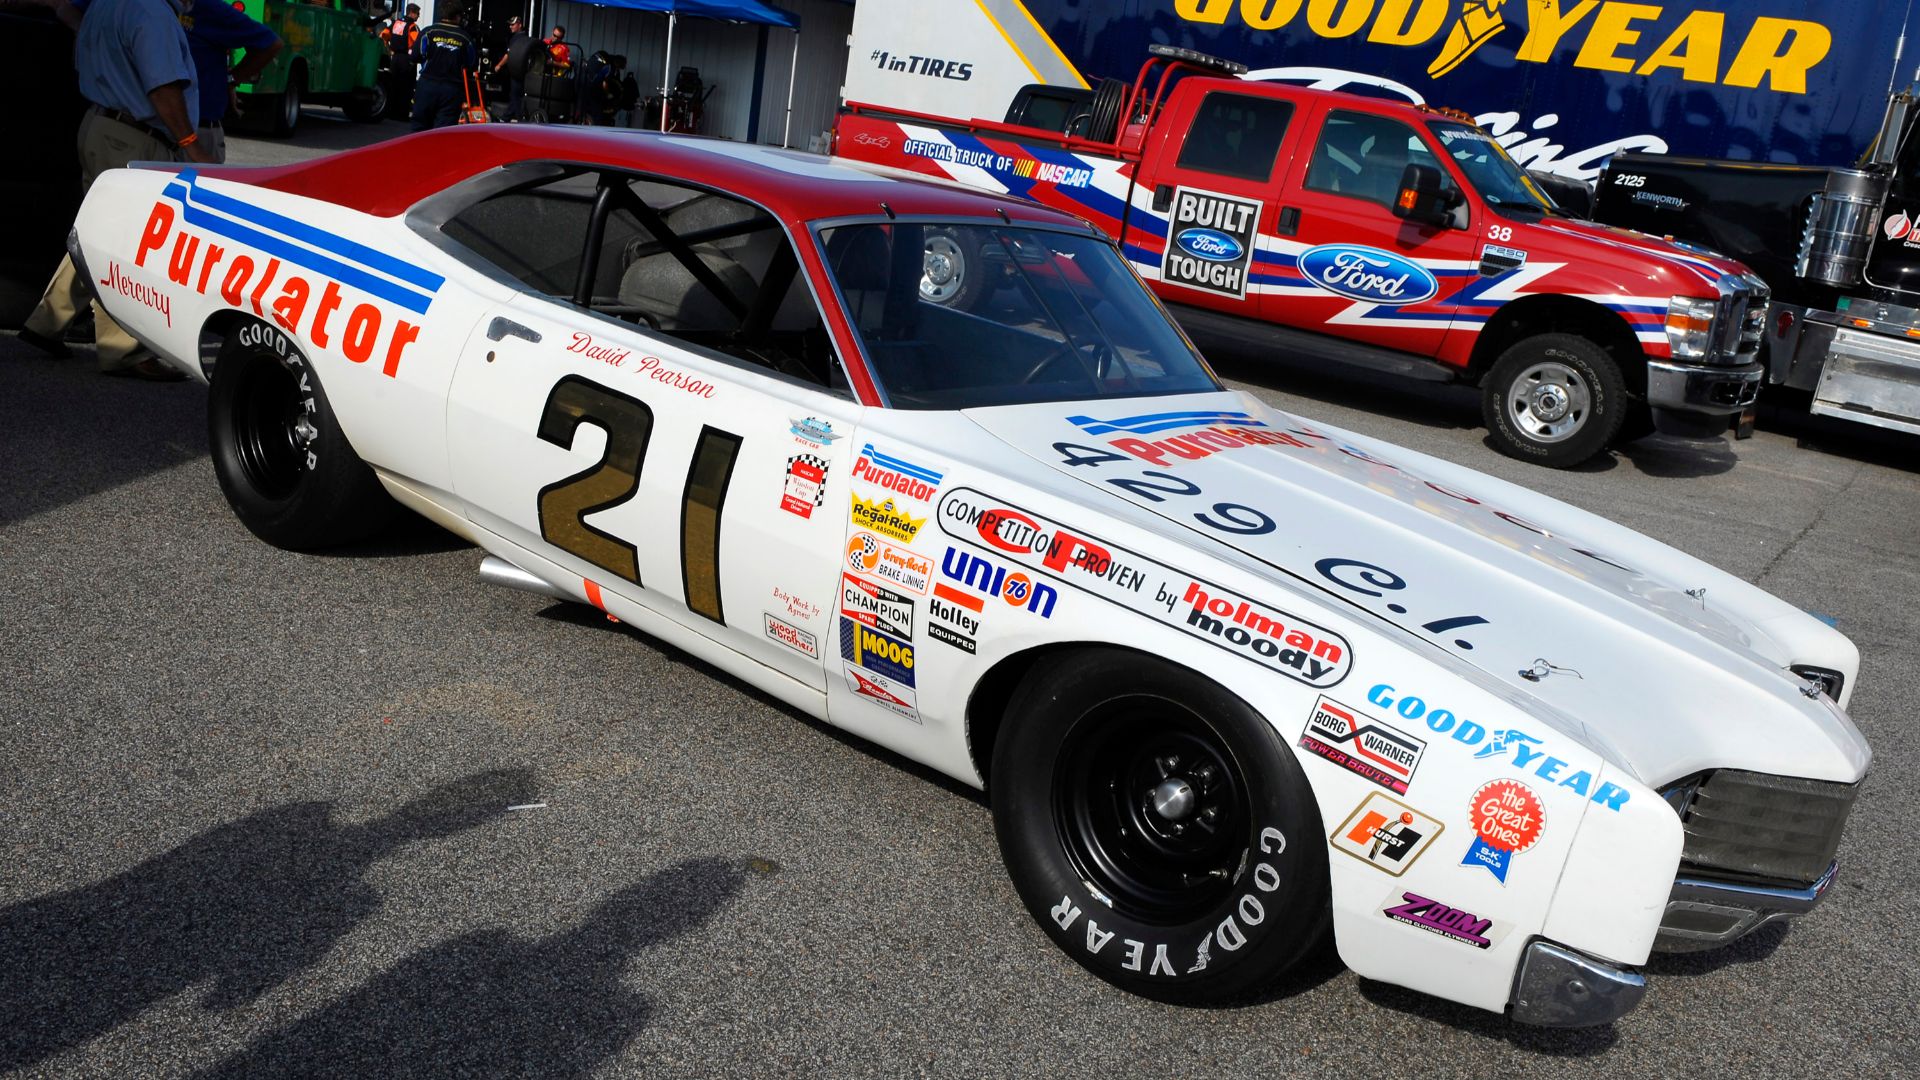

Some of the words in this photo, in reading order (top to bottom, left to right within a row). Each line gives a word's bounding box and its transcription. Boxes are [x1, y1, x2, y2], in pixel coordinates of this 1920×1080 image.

[908, 55, 974, 82] TIRES
[903, 139, 953, 160] OFFICIAL
[955, 148, 992, 168] TRUCK
[996, 157, 1013, 171] OF
[1036, 162, 1092, 189] NASCAR
[1615, 174, 1646, 187] 2125
[1178, 194, 1254, 234] BUILT
[1635, 190, 1683, 207] KENWORTH
[1191, 234, 1226, 256] Ford
[1487, 225, 1512, 242] 38
[1169, 254, 1241, 291] TOUGH
[1323, 252, 1411, 298] Ford
[101, 260, 171, 328] Mercury
[134, 201, 421, 378] Purolator
[567, 331, 630, 368] David
[635, 355, 718, 400] Pearson
[852, 456, 937, 503] Purolator
[536, 373, 744, 628] 21
[855, 517, 873, 528] SHOCK
[876, 524, 908, 541] ABSORBERS
[878, 564, 901, 581] BRAKE
[902, 573, 925, 591] LINING
[946, 498, 1063, 559] COMPETITION
[1073, 548, 1146, 594] PROVEN
[1155, 582, 1179, 613] by
[1183, 582, 1342, 664] holman
[1006, 579, 1028, 599] 76
[773, 587, 789, 604] Body
[793, 596, 809, 610] Work
[845, 589, 909, 626] CHAMPION
[769, 619, 797, 637] wood
[876, 620, 894, 632] PLUGS
[929, 598, 979, 636] Holley
[777, 630, 814, 653] brothers
[862, 630, 914, 669] MOOG
[929, 626, 975, 651] EQUIPPED
[1186, 609, 1336, 681] moody
[1313, 711, 1347, 734] BORG
[1301, 736, 1347, 765] POWER
[1347, 757, 1395, 786] BRUTE
[1364, 733, 1415, 767] WARNER
[1480, 798, 1535, 831] Great
[1502, 787, 1526, 811] the
[1366, 825, 1406, 848] HURST
[1481, 817, 1520, 846] Ones
[1475, 852, 1502, 868] TOOLS
[1383, 892, 1493, 946] ZOOM
[1393, 914, 1413, 925] GEARS
[1413, 921, 1443, 935] CLUTCHES
[1444, 932, 1480, 947] FLYWHEELS
